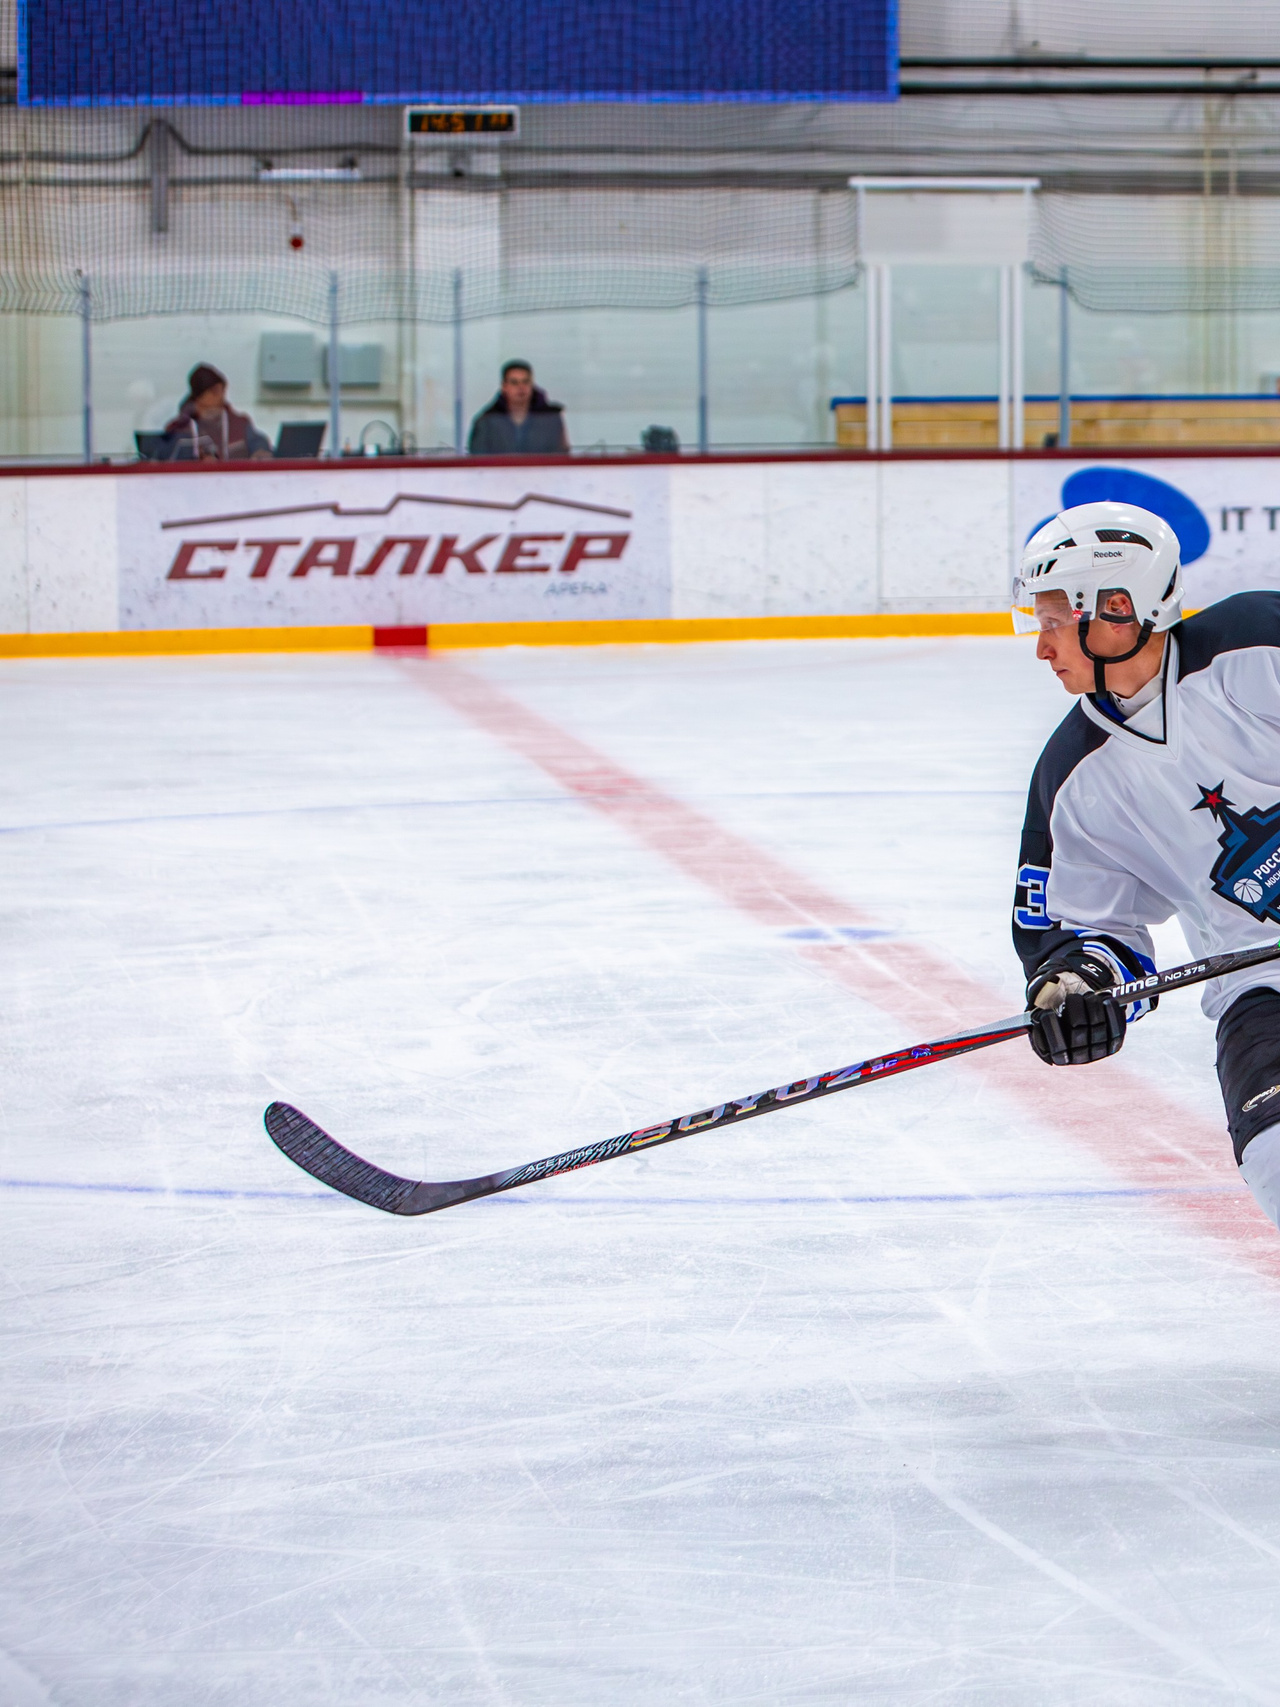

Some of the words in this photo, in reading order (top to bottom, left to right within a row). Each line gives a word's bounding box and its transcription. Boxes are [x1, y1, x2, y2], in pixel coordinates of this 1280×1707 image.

[1221, 506, 1251, 531] IT
[165, 531, 632, 580] СТАЛКЕР
[1093, 550, 1124, 559] Reebok
[629, 1060, 865, 1148] SOYUZ
[525, 1159, 555, 1174] ACE
